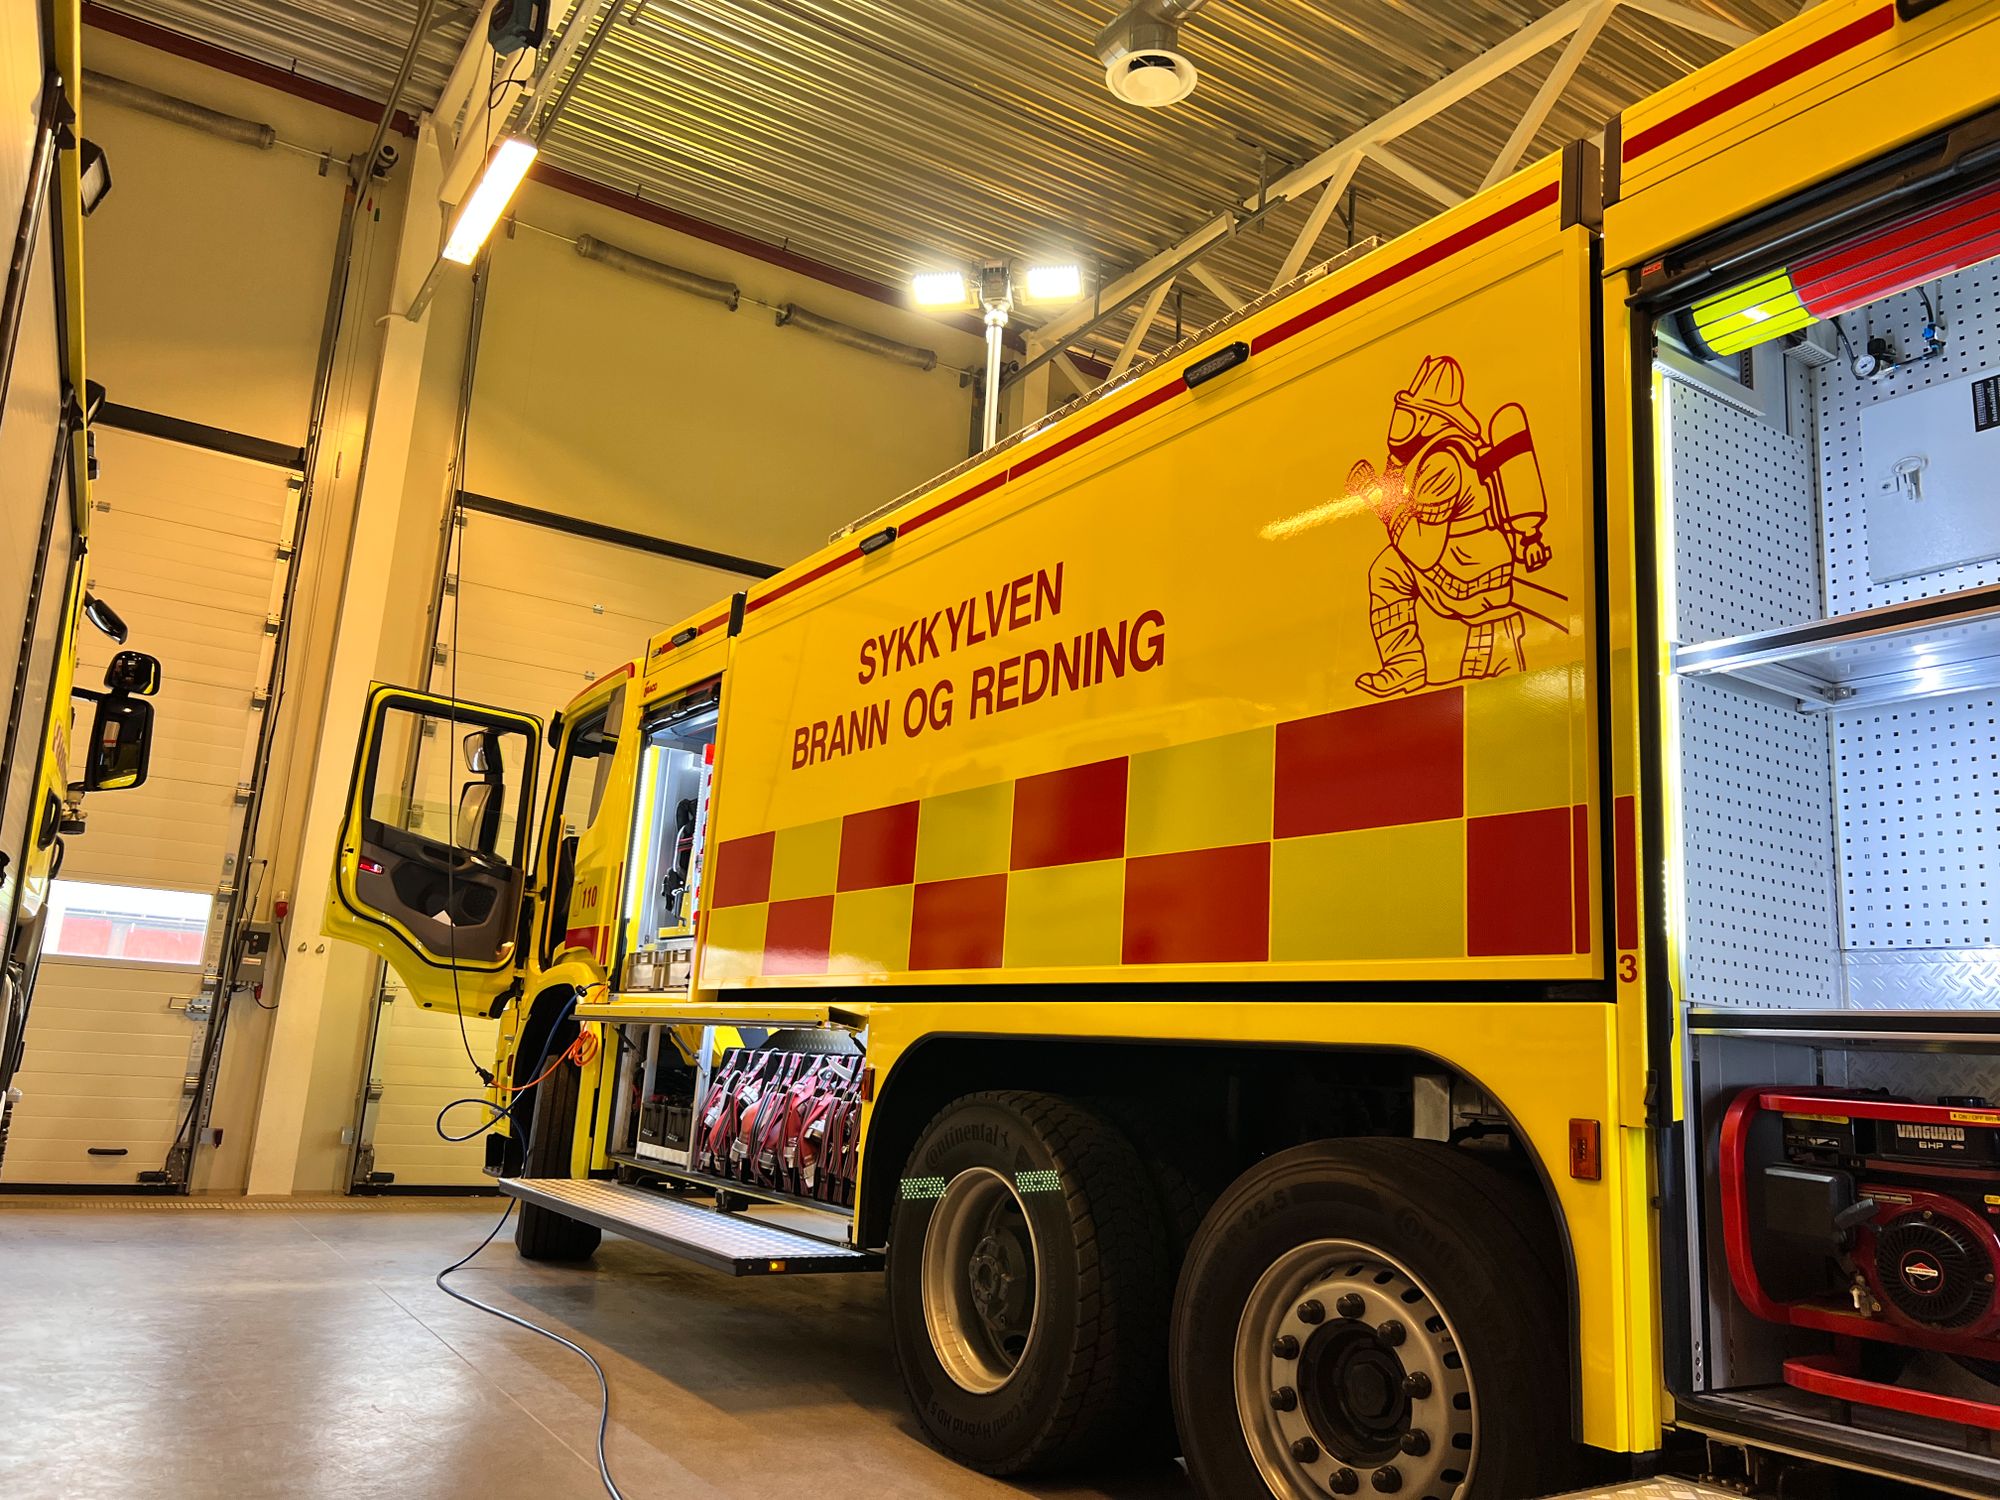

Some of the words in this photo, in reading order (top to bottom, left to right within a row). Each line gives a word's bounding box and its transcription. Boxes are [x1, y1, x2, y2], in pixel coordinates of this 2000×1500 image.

[859, 562, 1064, 685] SYKKYLVEN
[792, 699, 891, 771] BRANN
[904, 680, 954, 738] OG
[970, 609, 1165, 720] REDNING
[582, 885, 598, 908] 110
[1618, 953, 1638, 984] 3
[924, 1121, 1000, 1172] Continental
[1896, 1124, 1965, 1141] VANGUARD
